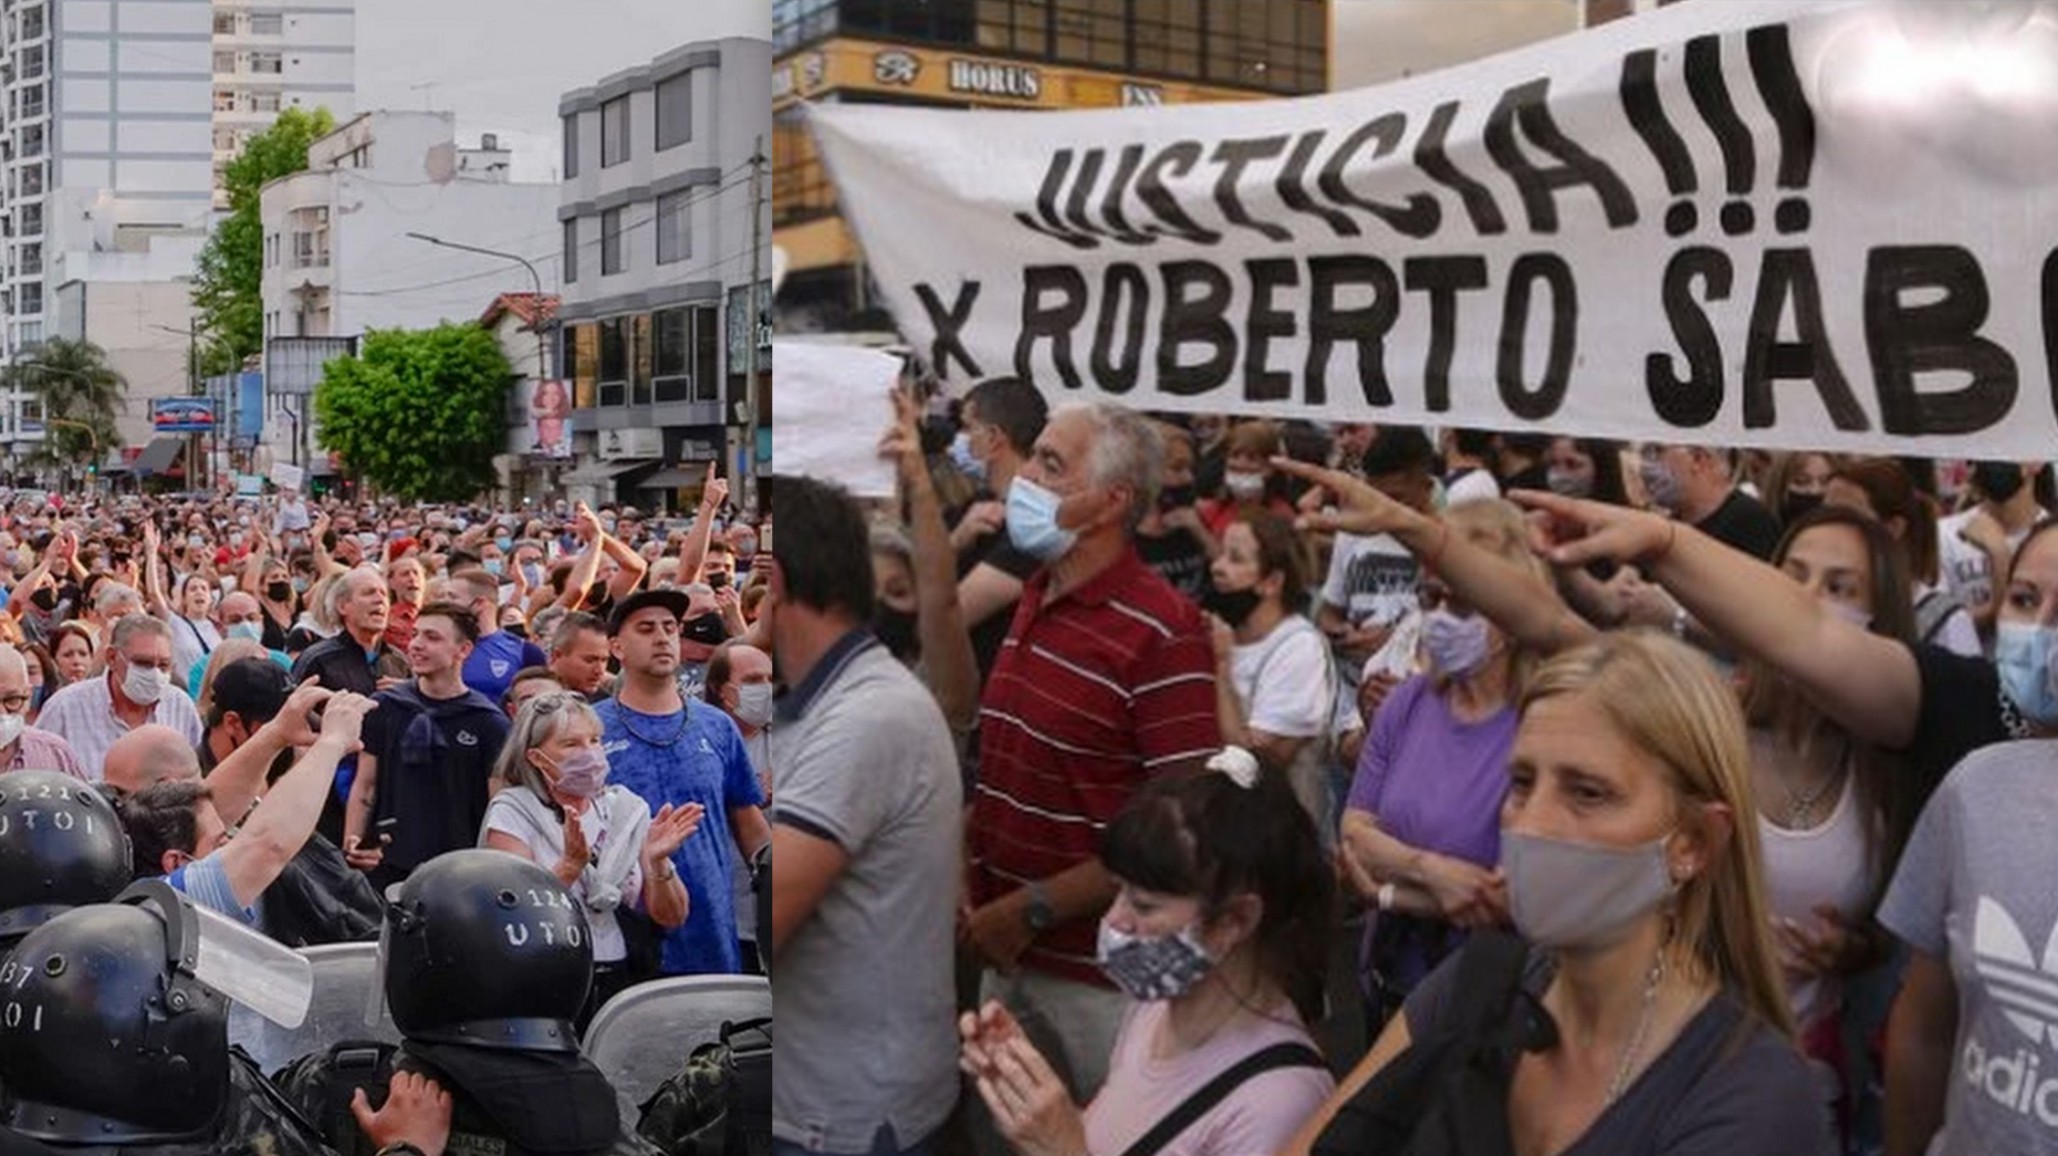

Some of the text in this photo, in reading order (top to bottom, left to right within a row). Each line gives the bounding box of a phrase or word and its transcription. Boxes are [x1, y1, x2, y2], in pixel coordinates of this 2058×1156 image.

[950, 60, 1038, 97] HORUS
[1013, 22, 1816, 249] JUSTICIA!!!
[913, 281, 982, 380] X
[1014, 252, 1578, 421] ROBERTO
[19, 785, 71, 801] 121
